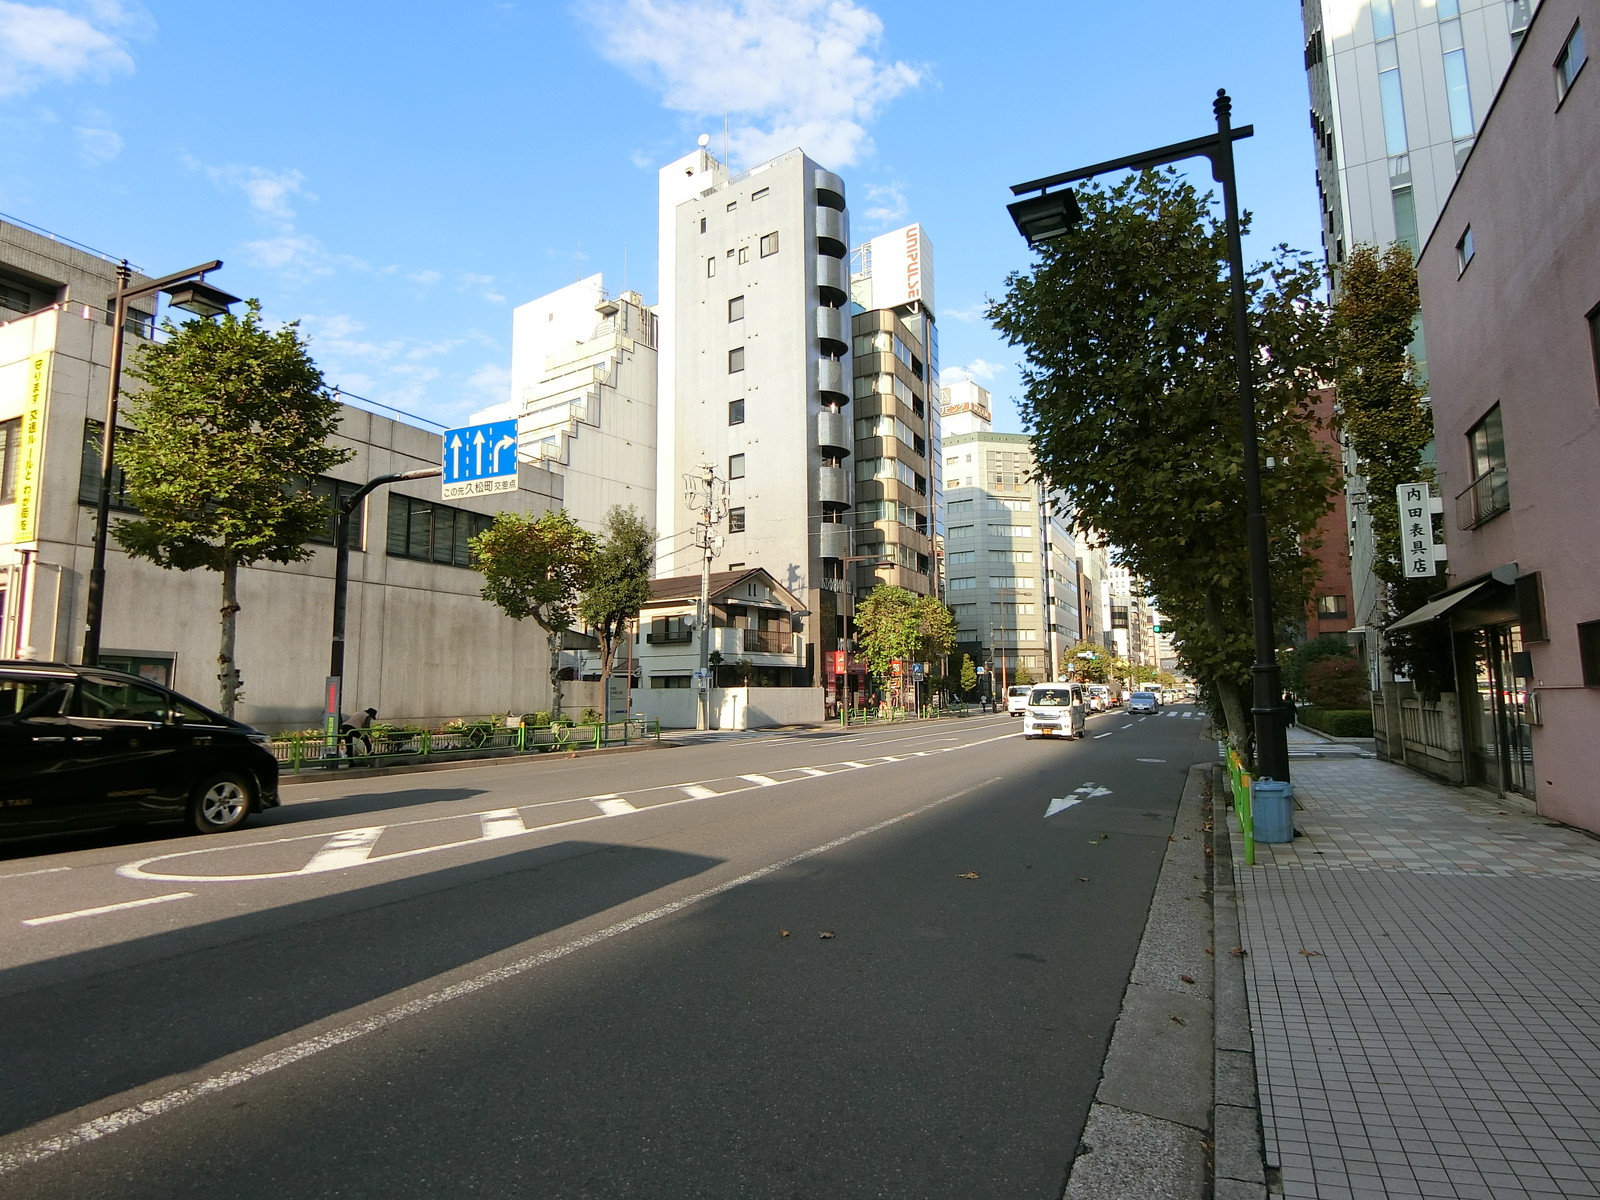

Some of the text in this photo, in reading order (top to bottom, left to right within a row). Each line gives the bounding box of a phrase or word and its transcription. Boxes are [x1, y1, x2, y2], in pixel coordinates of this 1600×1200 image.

[906, 227, 919, 299] UNIPULSE
[1407, 487, 1427, 573] 内田表具店
